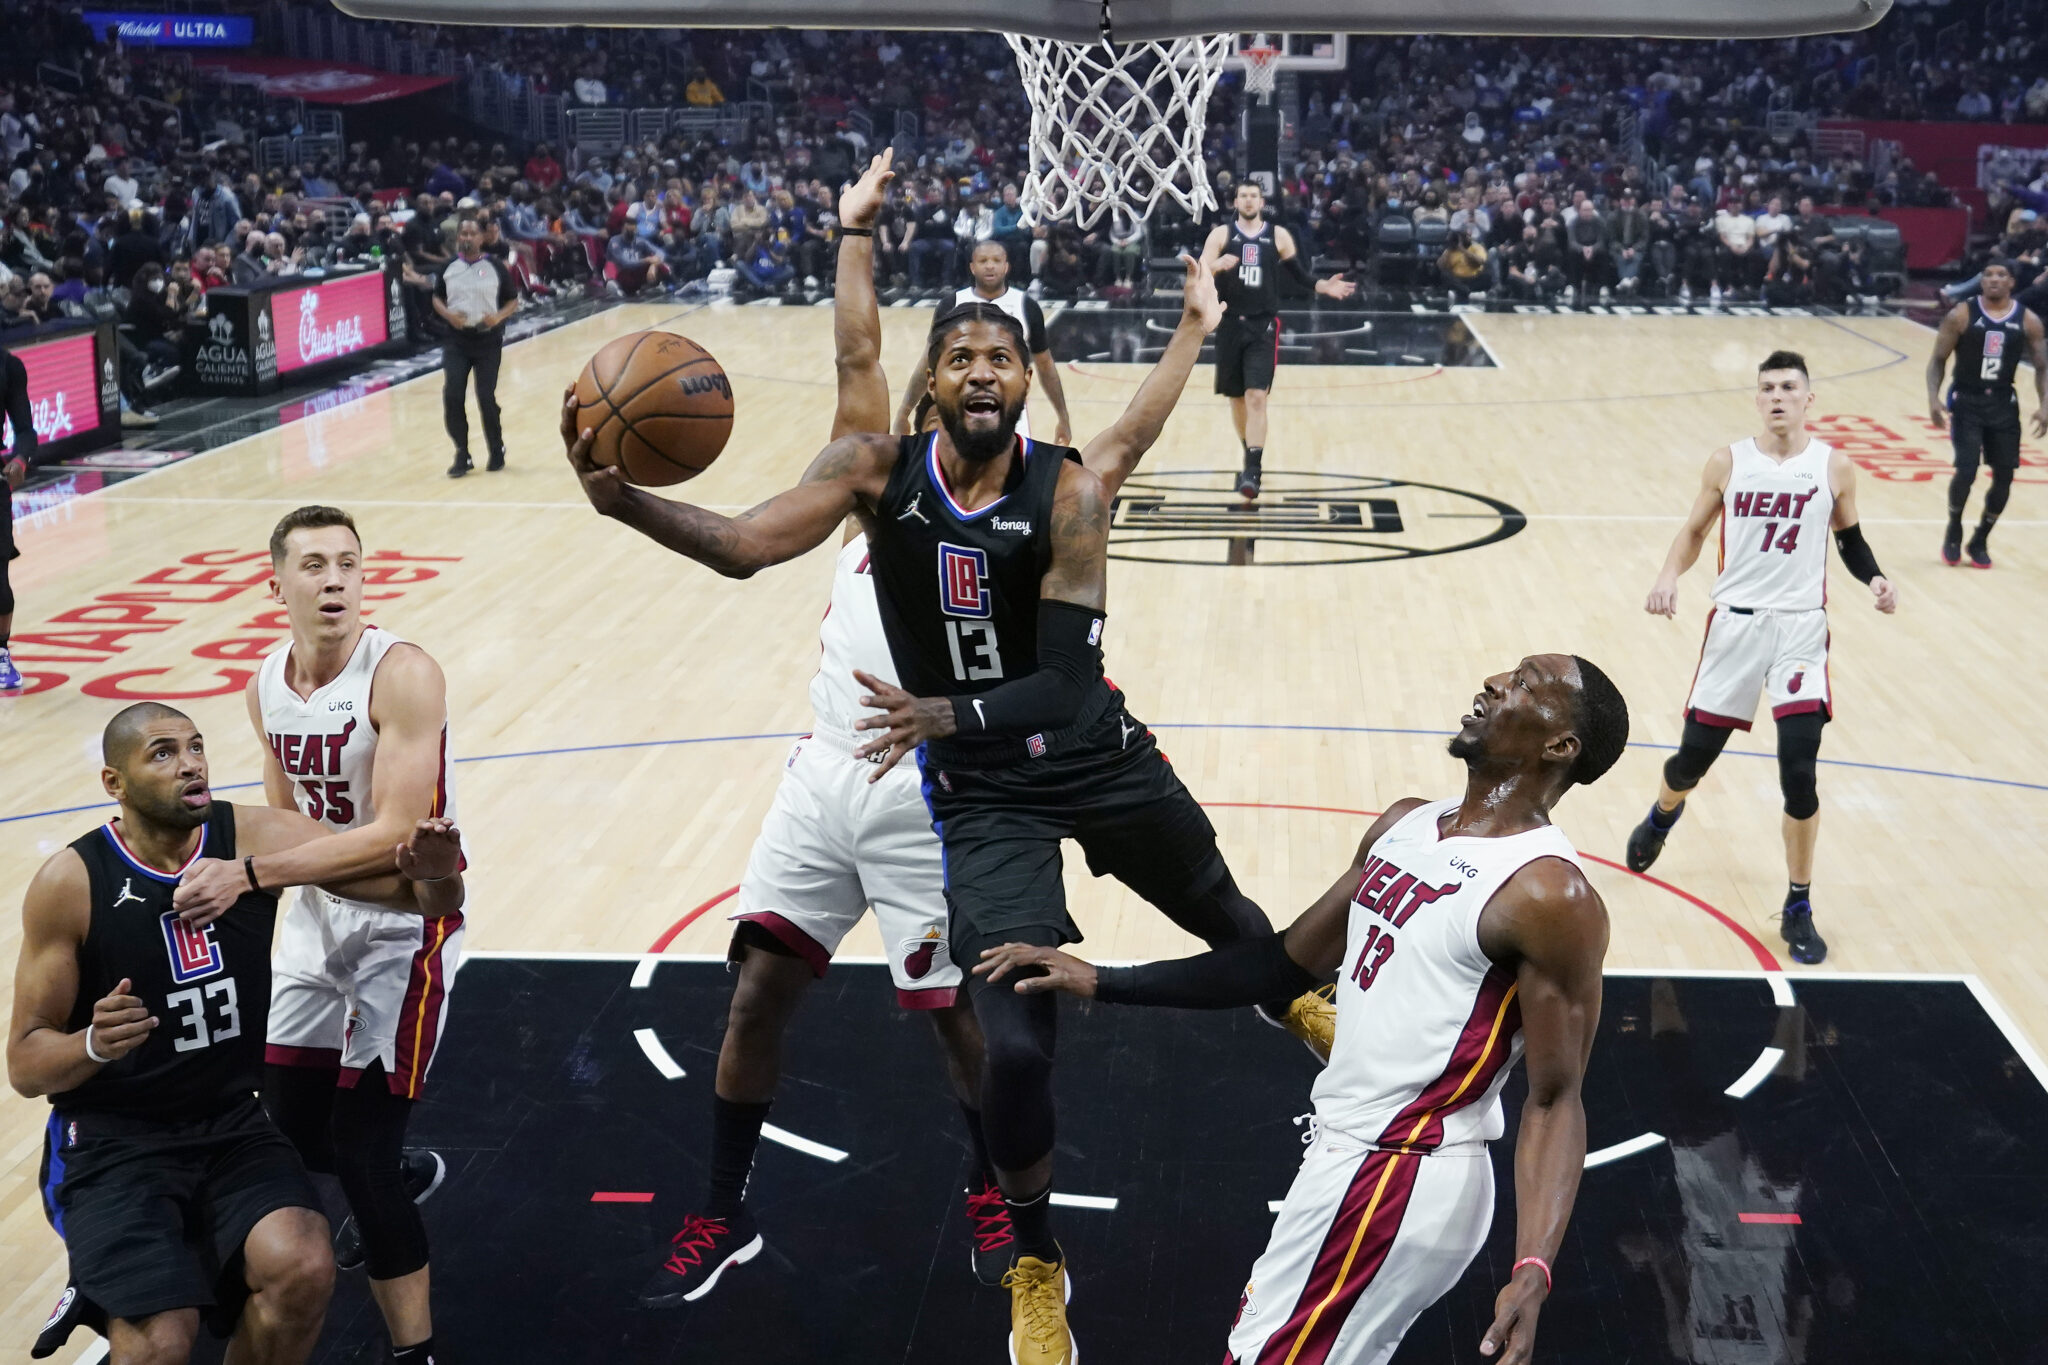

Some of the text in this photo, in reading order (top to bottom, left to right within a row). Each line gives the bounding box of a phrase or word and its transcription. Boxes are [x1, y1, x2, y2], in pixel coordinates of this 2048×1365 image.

[174, 22, 227, 38] ULTRA
[1239, 265, 1262, 287] 40
[195, 345, 248, 363] AGUA
[255, 341, 277, 361] AGUA
[195, 361, 249, 376] CALIENTE
[1981, 357, 2001, 380] 12
[1734, 485, 1819, 520] HEAT
[990, 516, 1032, 536] honey
[1760, 522, 1801, 555] 14
[944, 620, 1004, 681] 13
[1352, 854, 1462, 930] HEAT
[1350, 924, 1395, 993] 13
[166, 976, 241, 1053] 33
